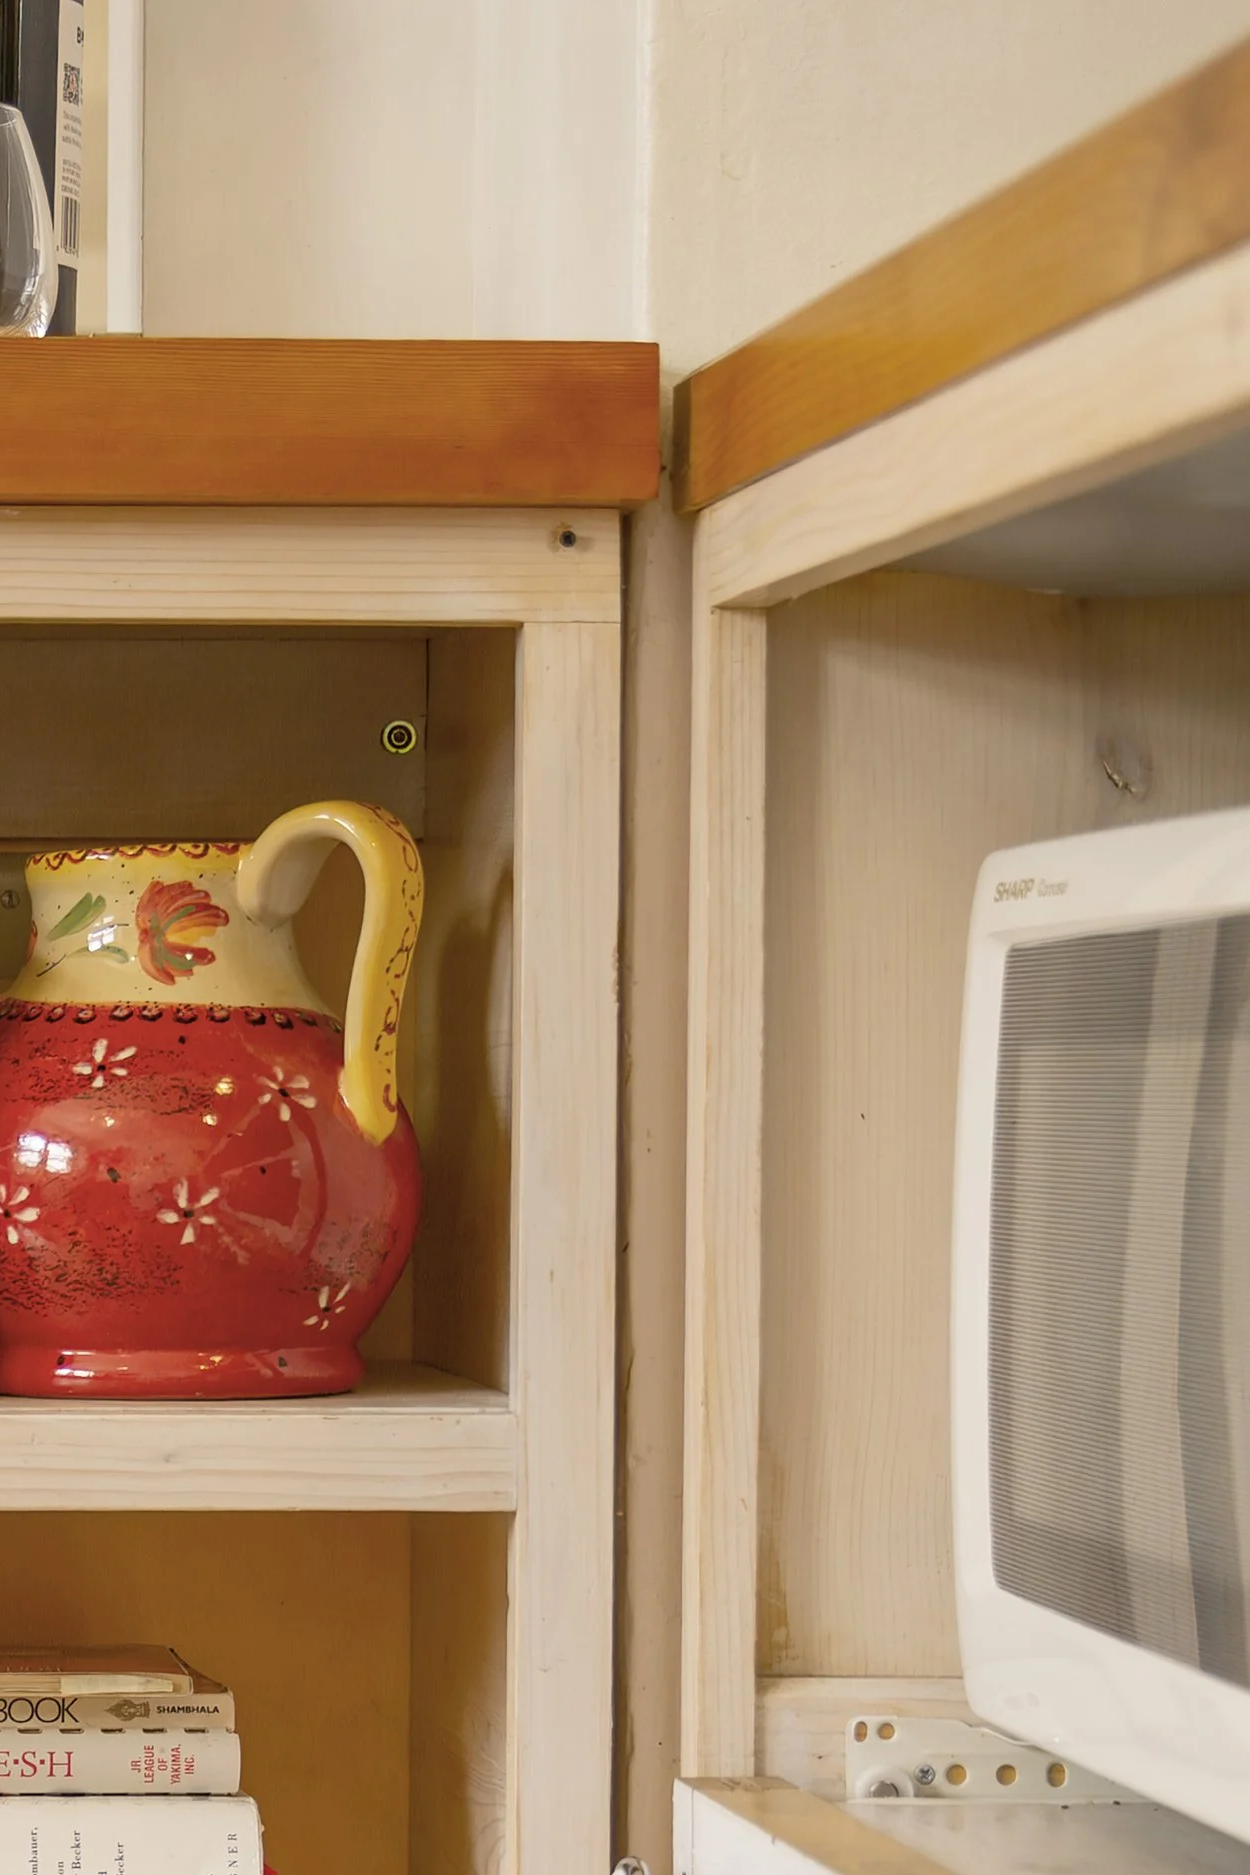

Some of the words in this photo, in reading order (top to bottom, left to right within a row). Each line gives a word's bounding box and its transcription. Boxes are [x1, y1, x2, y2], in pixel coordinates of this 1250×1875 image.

[993, 878, 1035, 902] SHARP
[156, 1706, 220, 1715] SHAMBHALA
[131, 1756, 141, 1773] JR.
[144, 1745, 154, 1783] LEAGUE
[158, 1758, 168, 1771] OF
[170, 1743, 182, 1785] YAKIMA,
[184, 1754, 195, 1774] INC.
[71, 1830, 81, 1870] Becker
